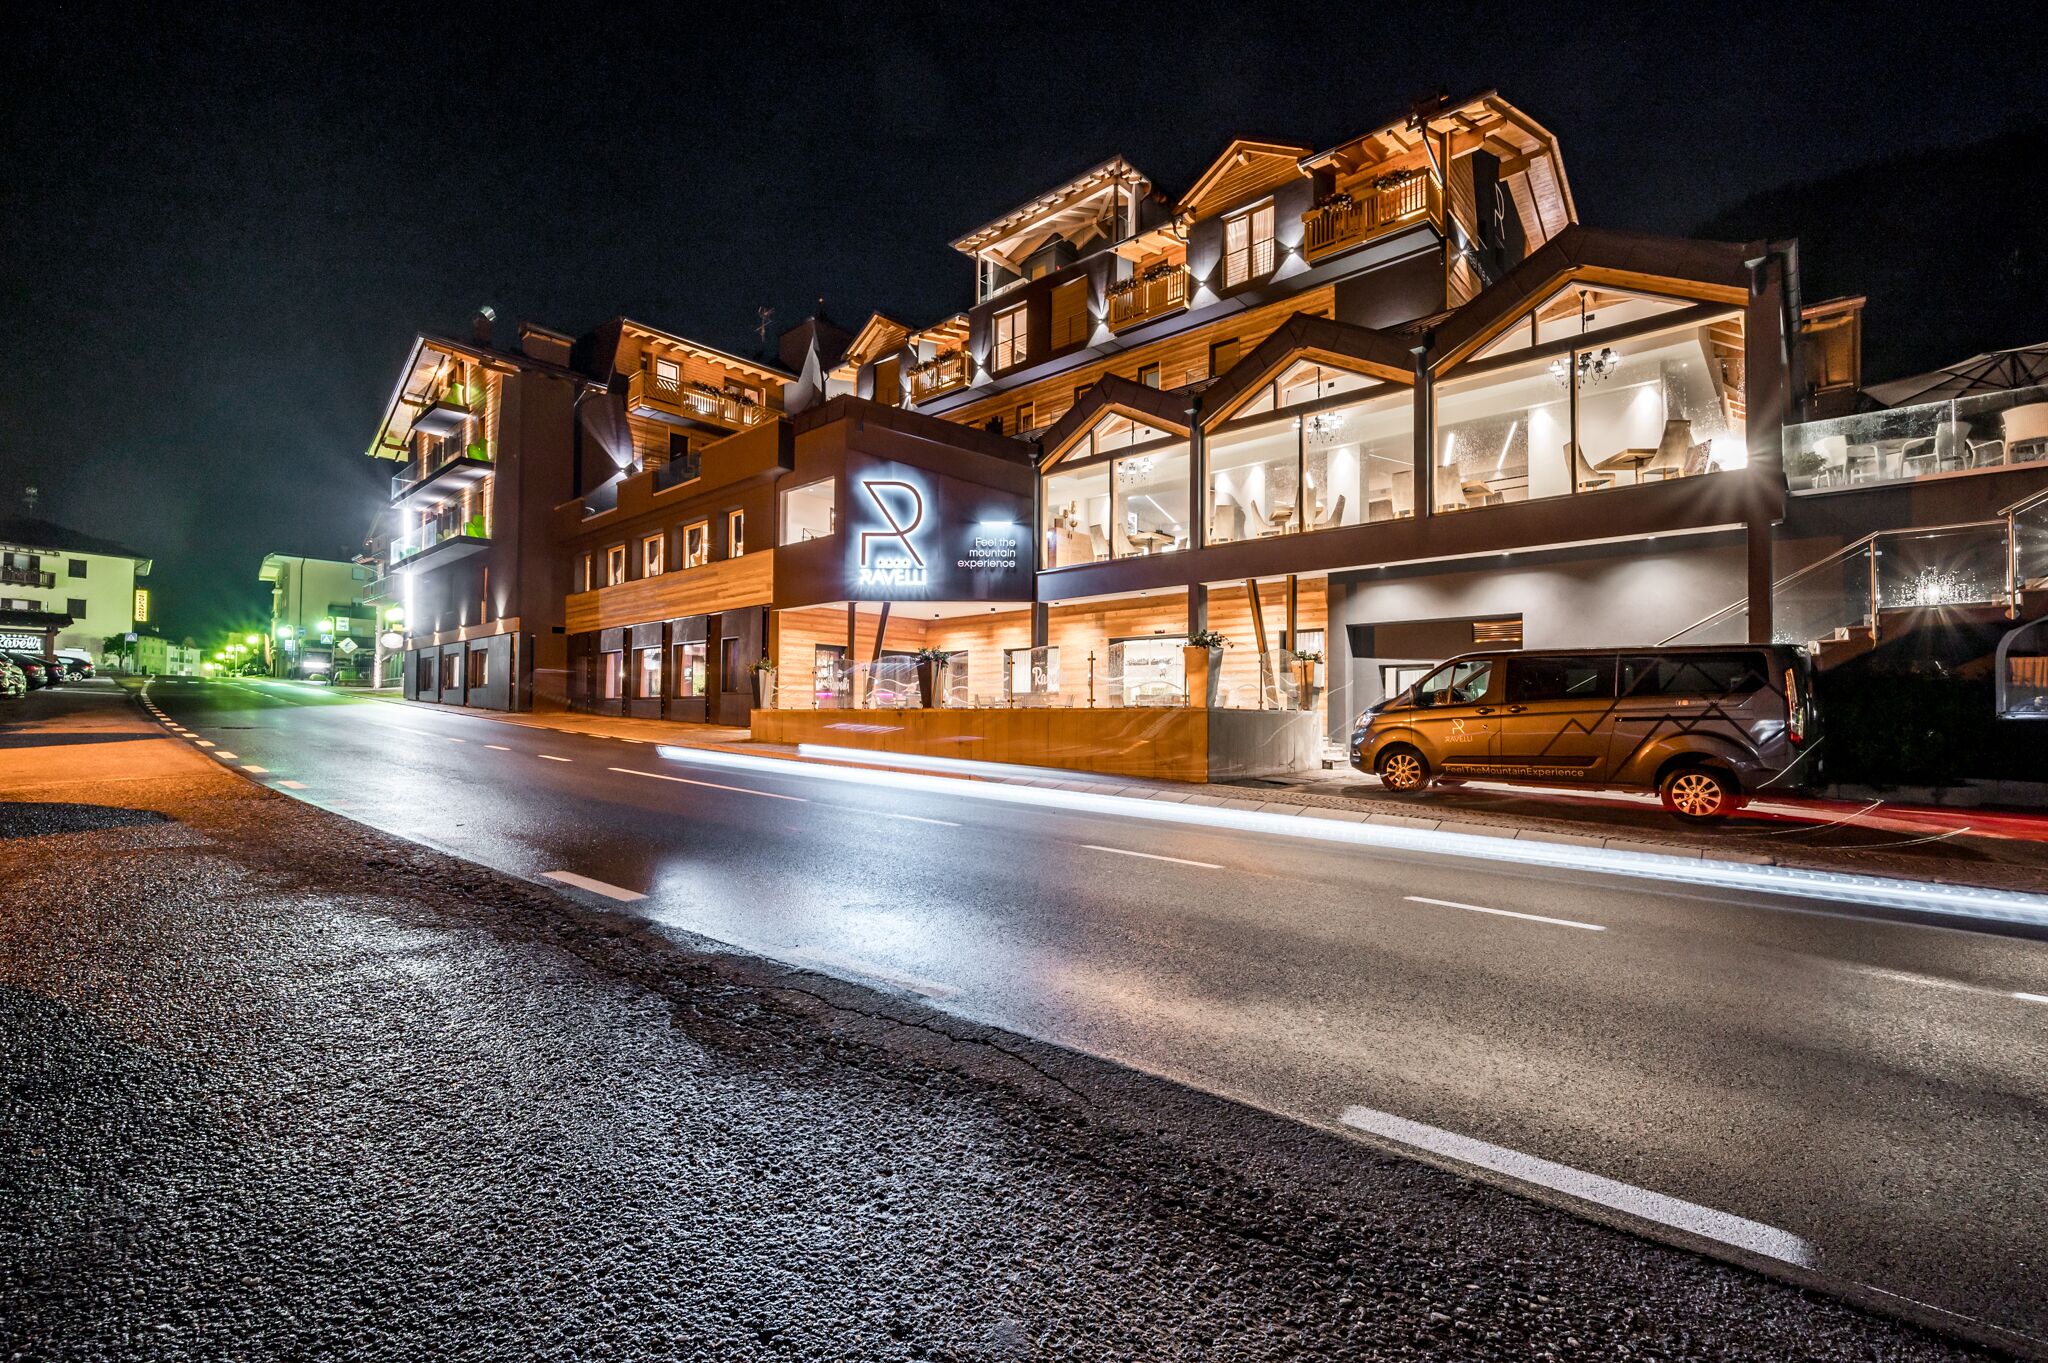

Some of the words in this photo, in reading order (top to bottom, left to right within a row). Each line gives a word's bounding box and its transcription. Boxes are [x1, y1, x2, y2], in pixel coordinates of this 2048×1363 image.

[861, 480, 924, 567] R
[974, 537, 997, 547] Feel
[998, 537, 1016, 547] the
[968, 548, 1016, 558] mountain
[957, 558, 1016, 570] experience
[859, 569, 927, 585] RAVELLI
[1446, 766, 1584, 777] FeelTheMountainExperience
